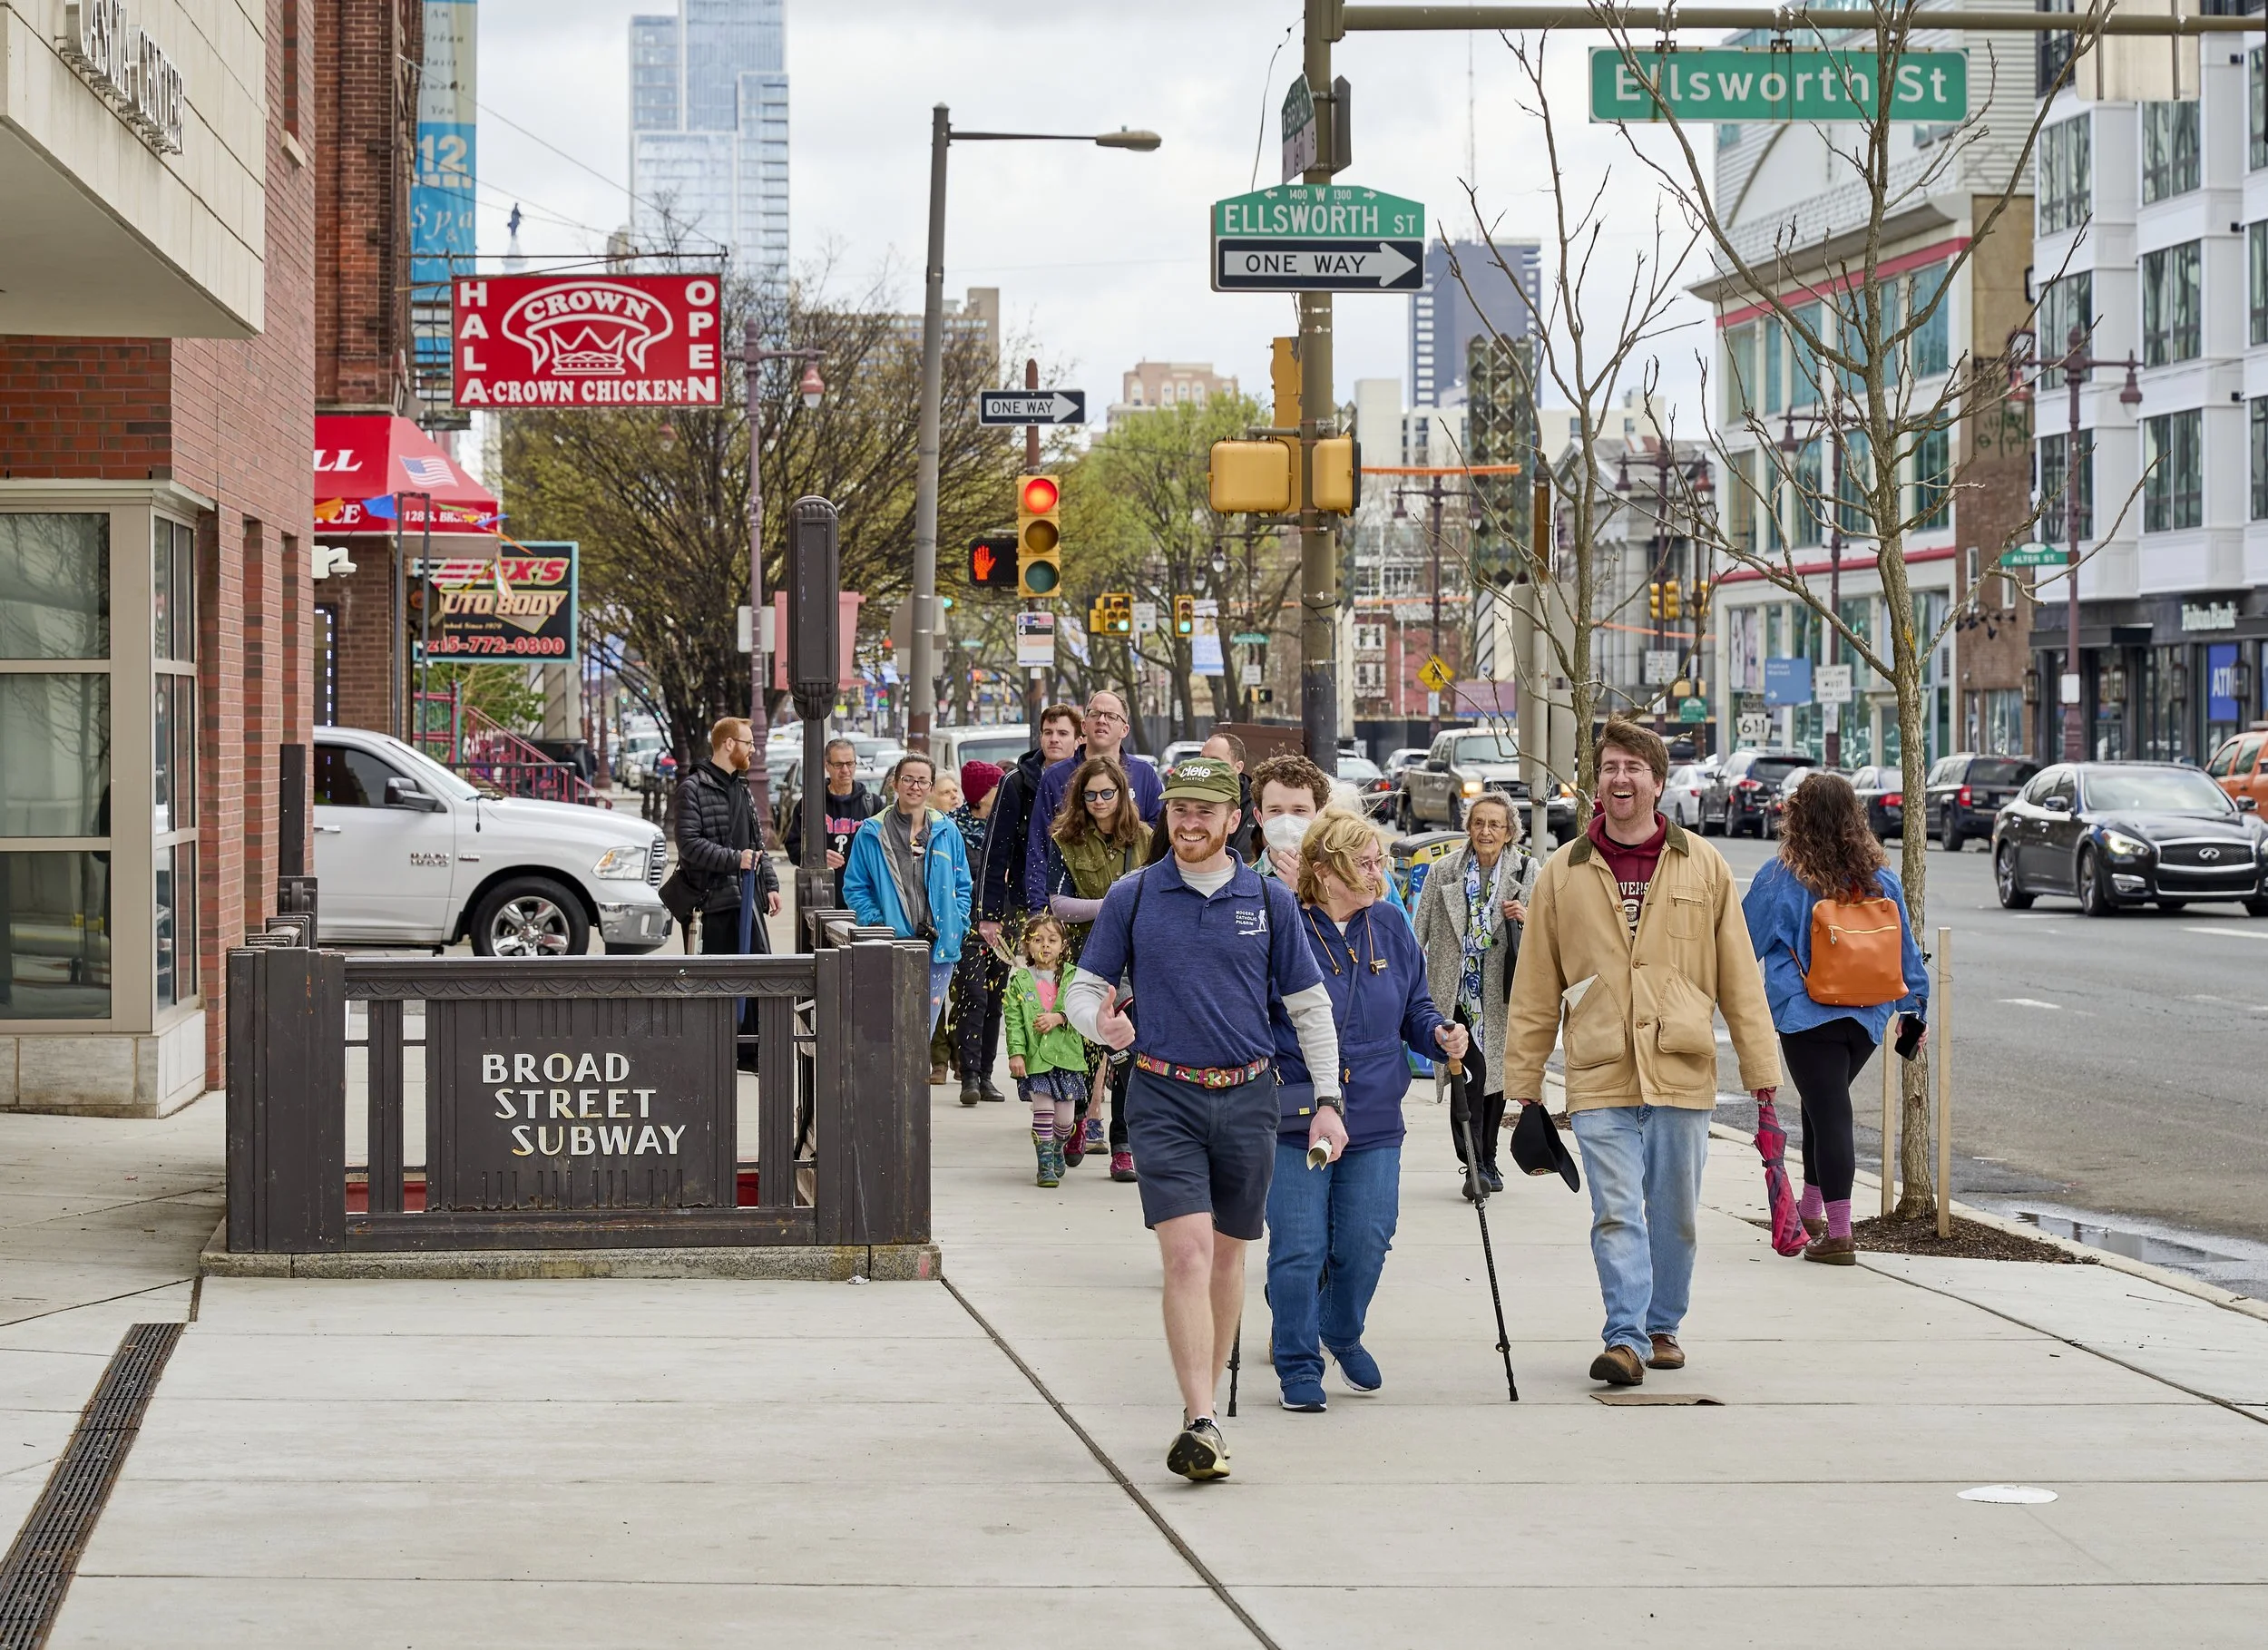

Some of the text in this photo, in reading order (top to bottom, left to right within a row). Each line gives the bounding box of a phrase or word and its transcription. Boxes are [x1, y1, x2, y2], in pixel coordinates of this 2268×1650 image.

[137, 24, 184, 156] CENTER
[1615, 62, 1948, 103] Ellsworth St
[418, 134, 467, 172] 12
[1289, 188, 1352, 201] 1400 W 1300
[412, 203, 473, 240] Spa
[1225, 205, 1415, 234] ELLSWORTH ST
[1246, 254, 1366, 273] ONE WAY
[523, 290, 651, 322] CROWN
[493, 379, 682, 403] CROWN CHICKEN
[992, 401, 1053, 415] ONE WAY
[2012, 554, 2040, 563] ALTER
[494, 593, 568, 617] BODY
[1742, 719, 1765, 734] 611
[483, 1052, 630, 1083] BROAD
[494, 1089, 656, 1119] STREET
[512, 1124, 686, 1156] SUBWAY
